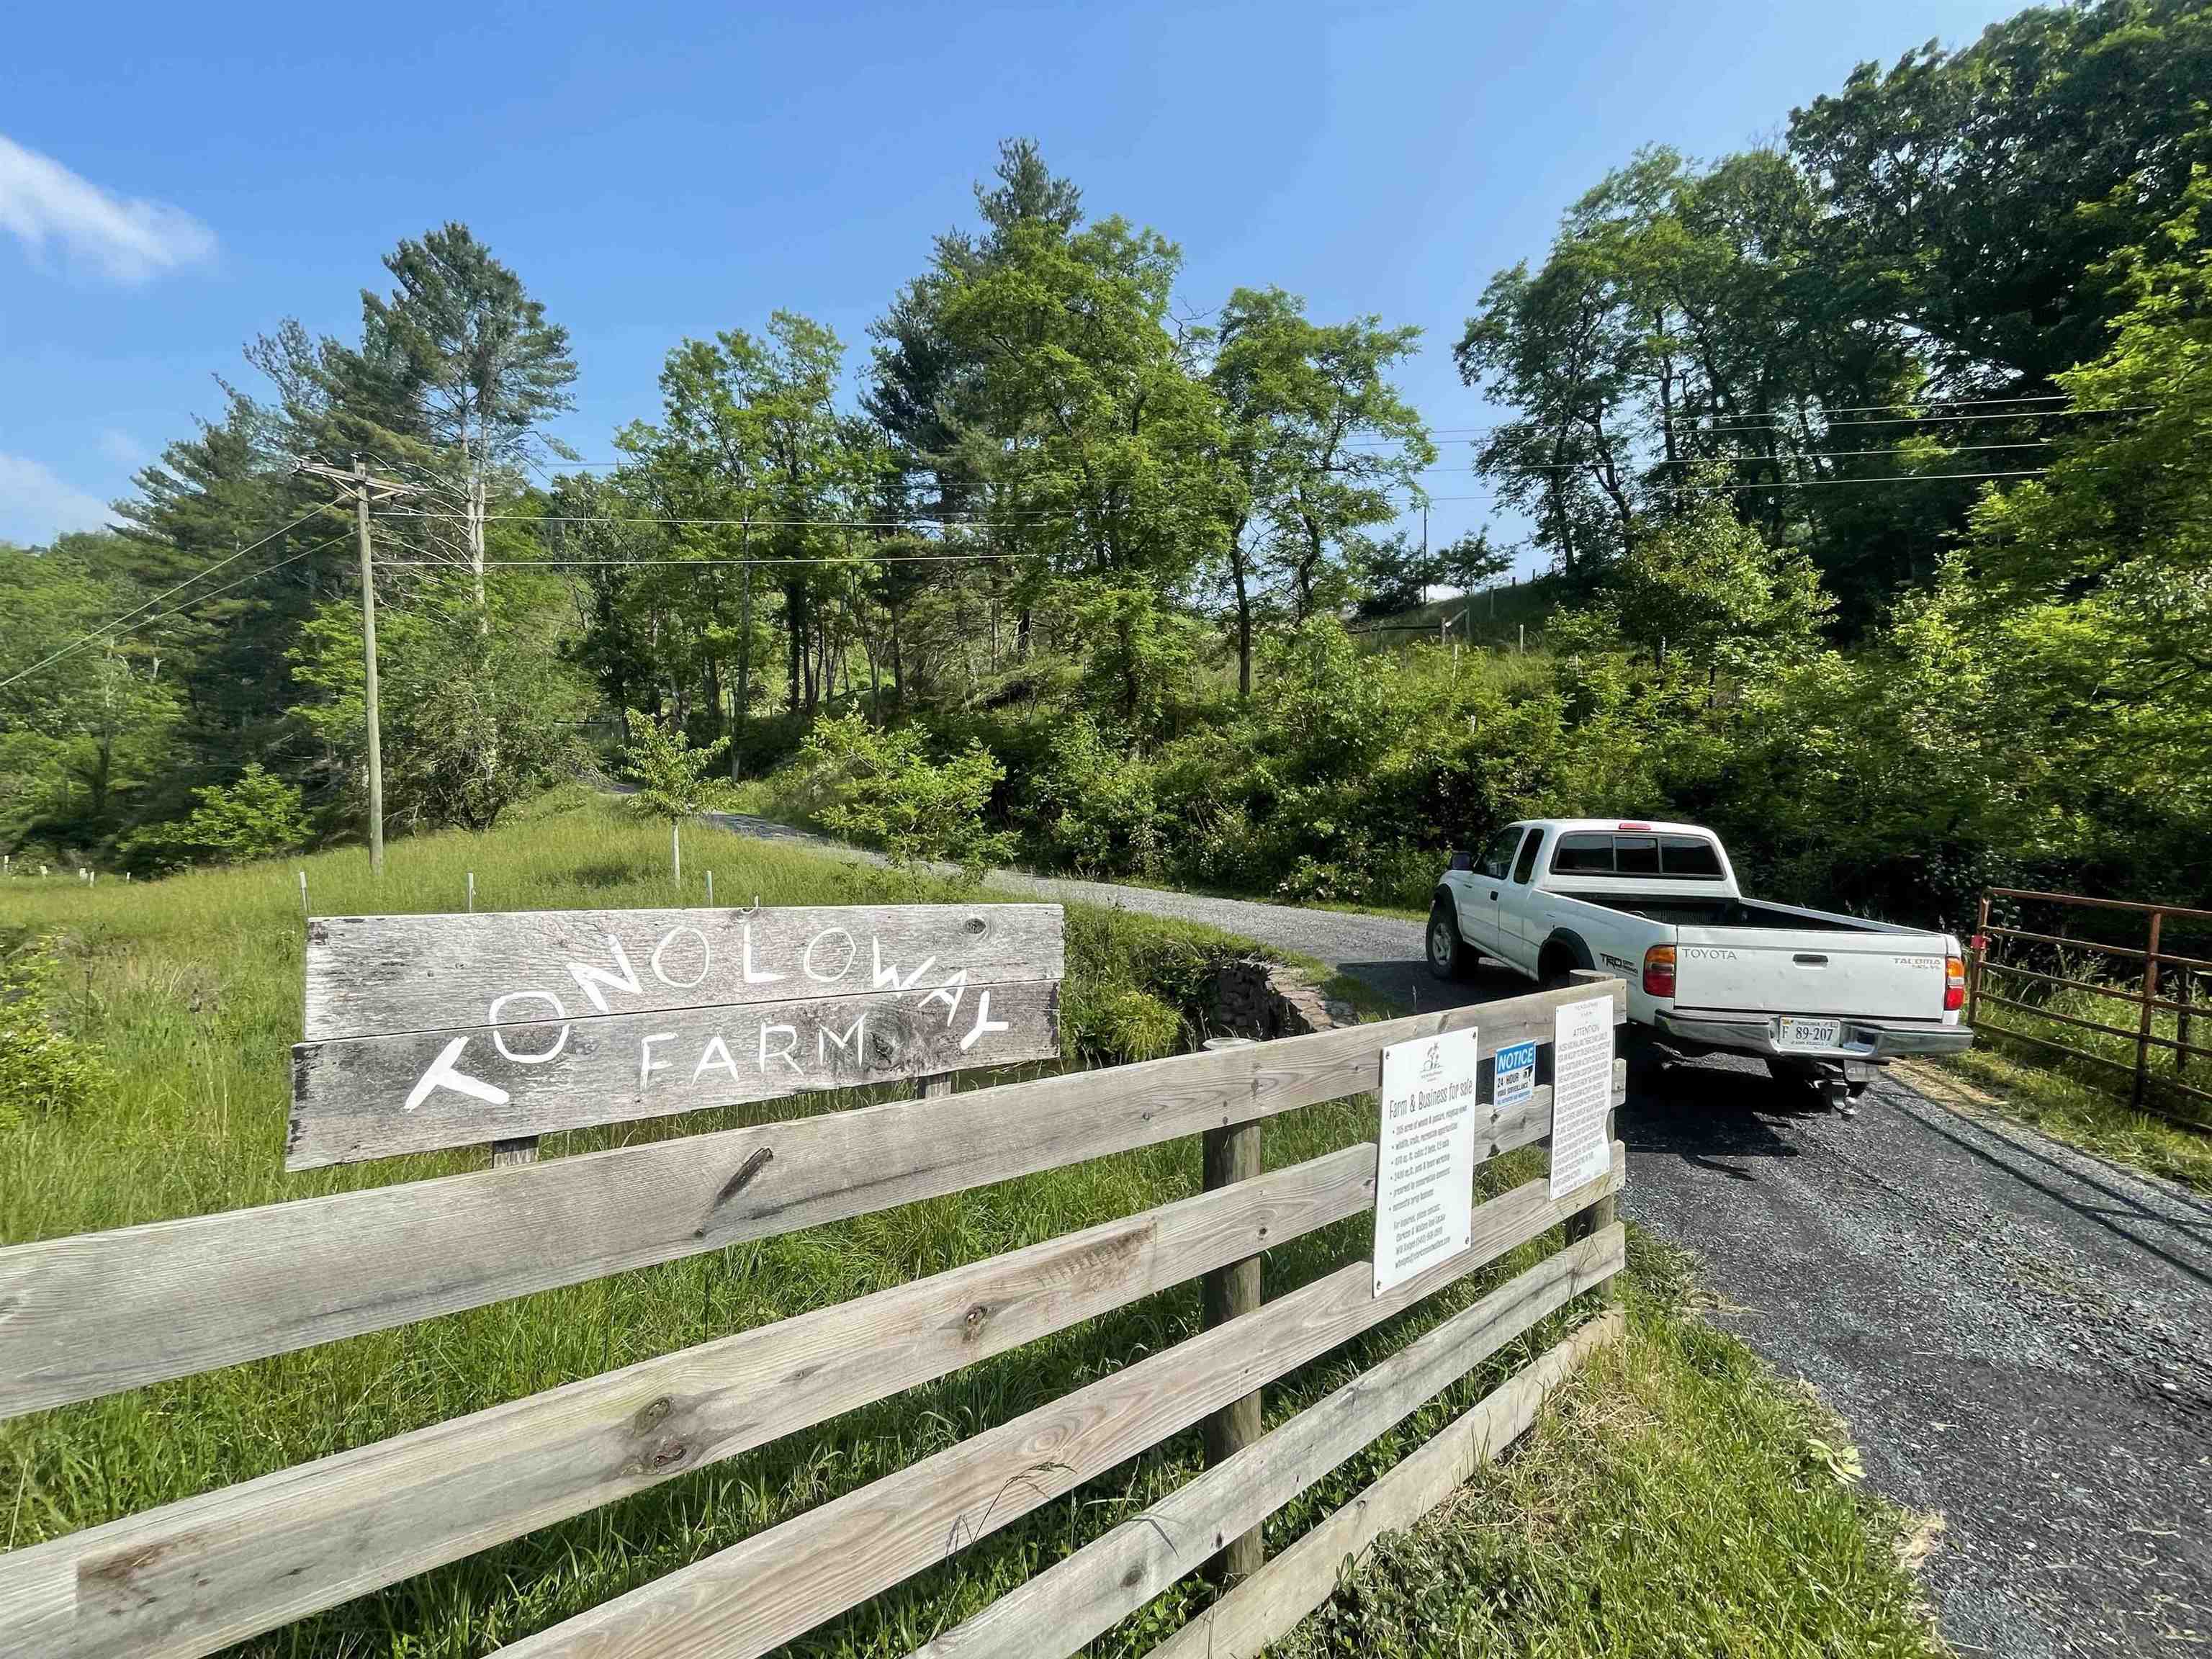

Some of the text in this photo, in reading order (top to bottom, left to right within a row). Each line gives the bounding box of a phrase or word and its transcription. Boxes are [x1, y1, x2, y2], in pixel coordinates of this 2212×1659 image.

[1600, 953, 1622, 970] TRD
[1682, 948, 1737, 961] TOYOTA
[404, 924, 1009, 1113] TONOLOWAY
[1782, 1025, 1833, 1041] F 89-207
[639, 1010, 865, 1092] FARM
[1498, 1047, 1534, 1071] NOTICE
[1389, 1079, 1473, 1119] Farm & Business for sale
